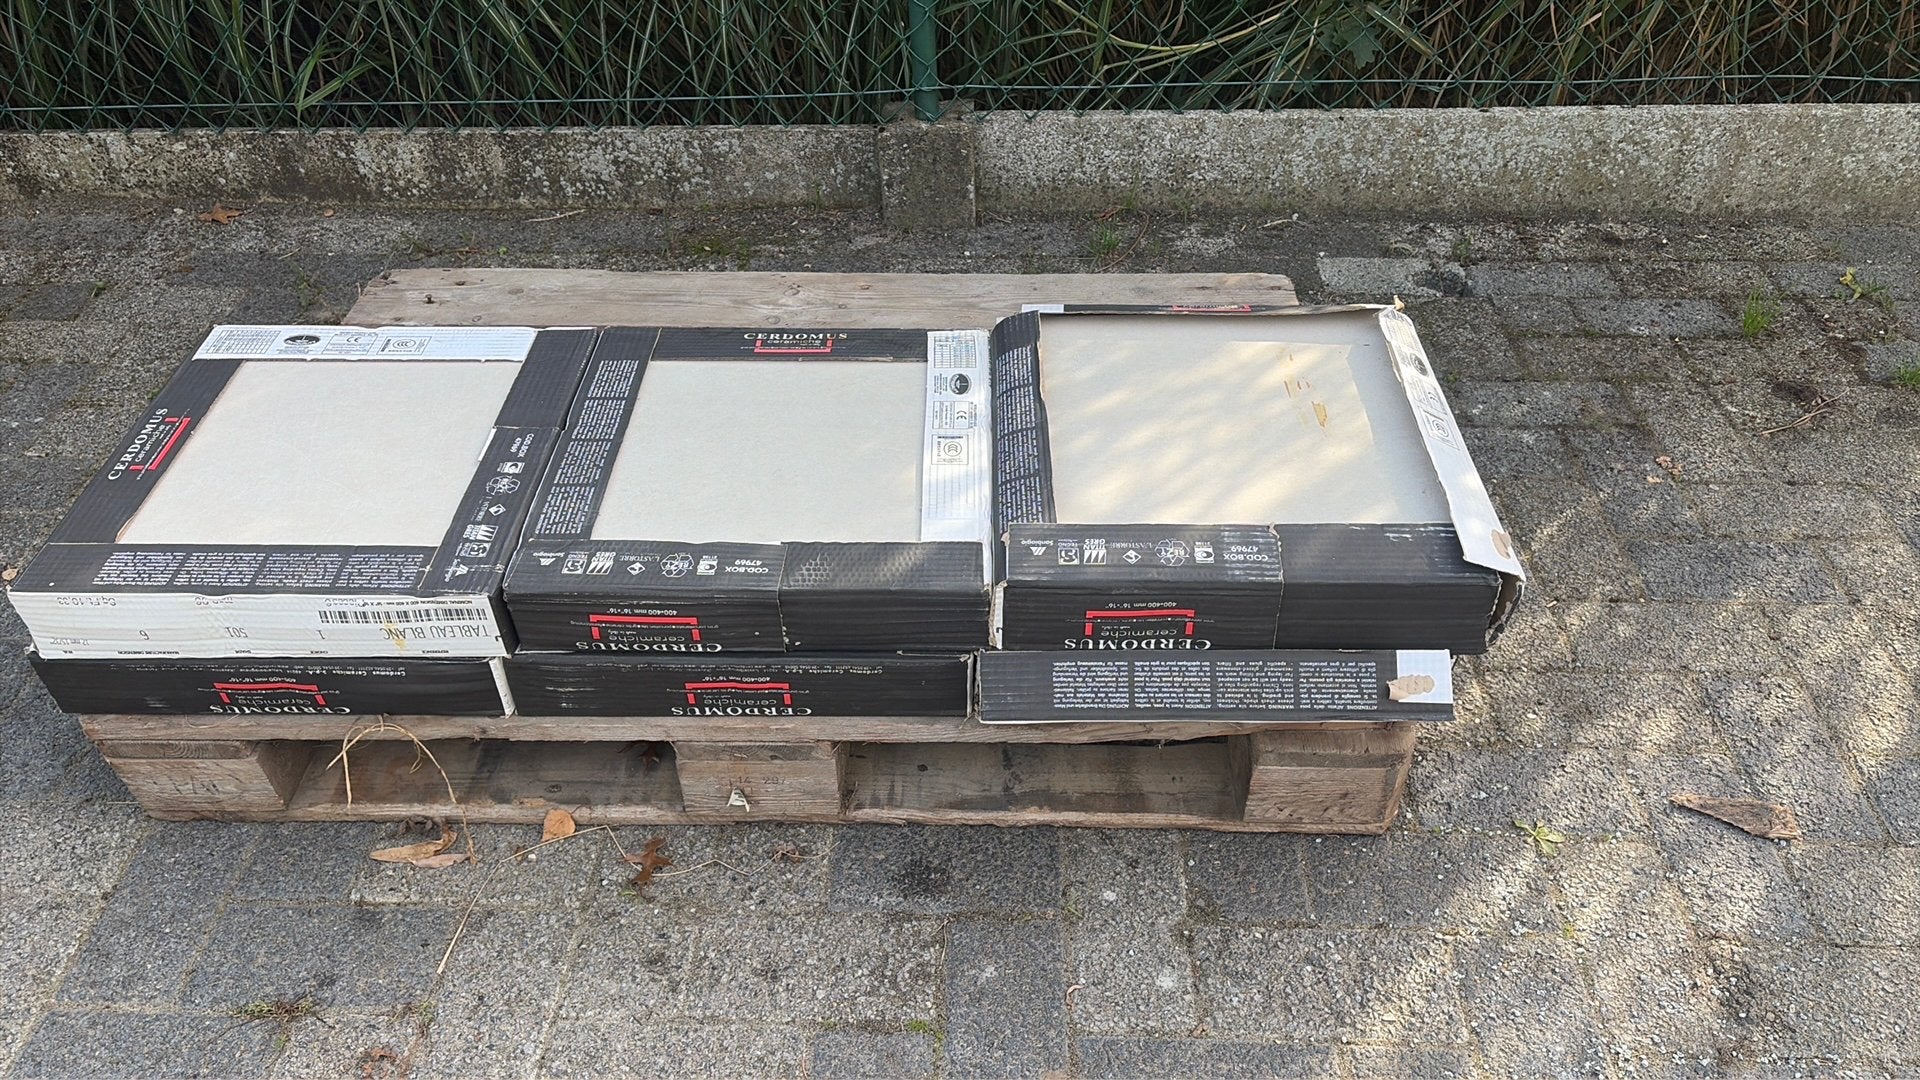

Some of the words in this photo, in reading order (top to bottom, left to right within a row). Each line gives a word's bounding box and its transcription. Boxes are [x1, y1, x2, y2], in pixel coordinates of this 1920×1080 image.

[108, 408, 168, 480] CERDOMUS
[136, 425, 165, 462] ceramiche
[517, 433, 534, 458] COD.BOX
[1021, 538, 1054, 546] Sanbiagio
[1223, 553, 1268, 561] COD.BOX
[138, 630, 149, 641] 6
[225, 626, 248, 638] 501
[315, 630, 325, 640] 1
[379, 626, 424, 640] BLANC
[429, 624, 490, 638] TABLEAU
[1100, 629, 1177, 638] ceramiche
[608, 635, 685, 643] ceramiche
[575, 641, 722, 652] CERDOMUS
[1064, 639, 1211, 650] CERDOMUS
[238, 698, 311, 706] ceramiche
[704, 698, 777, 706] ceramiche
[210, 705, 350, 714] CERDOMUS
[671, 706, 812, 716] CERDOMUS
